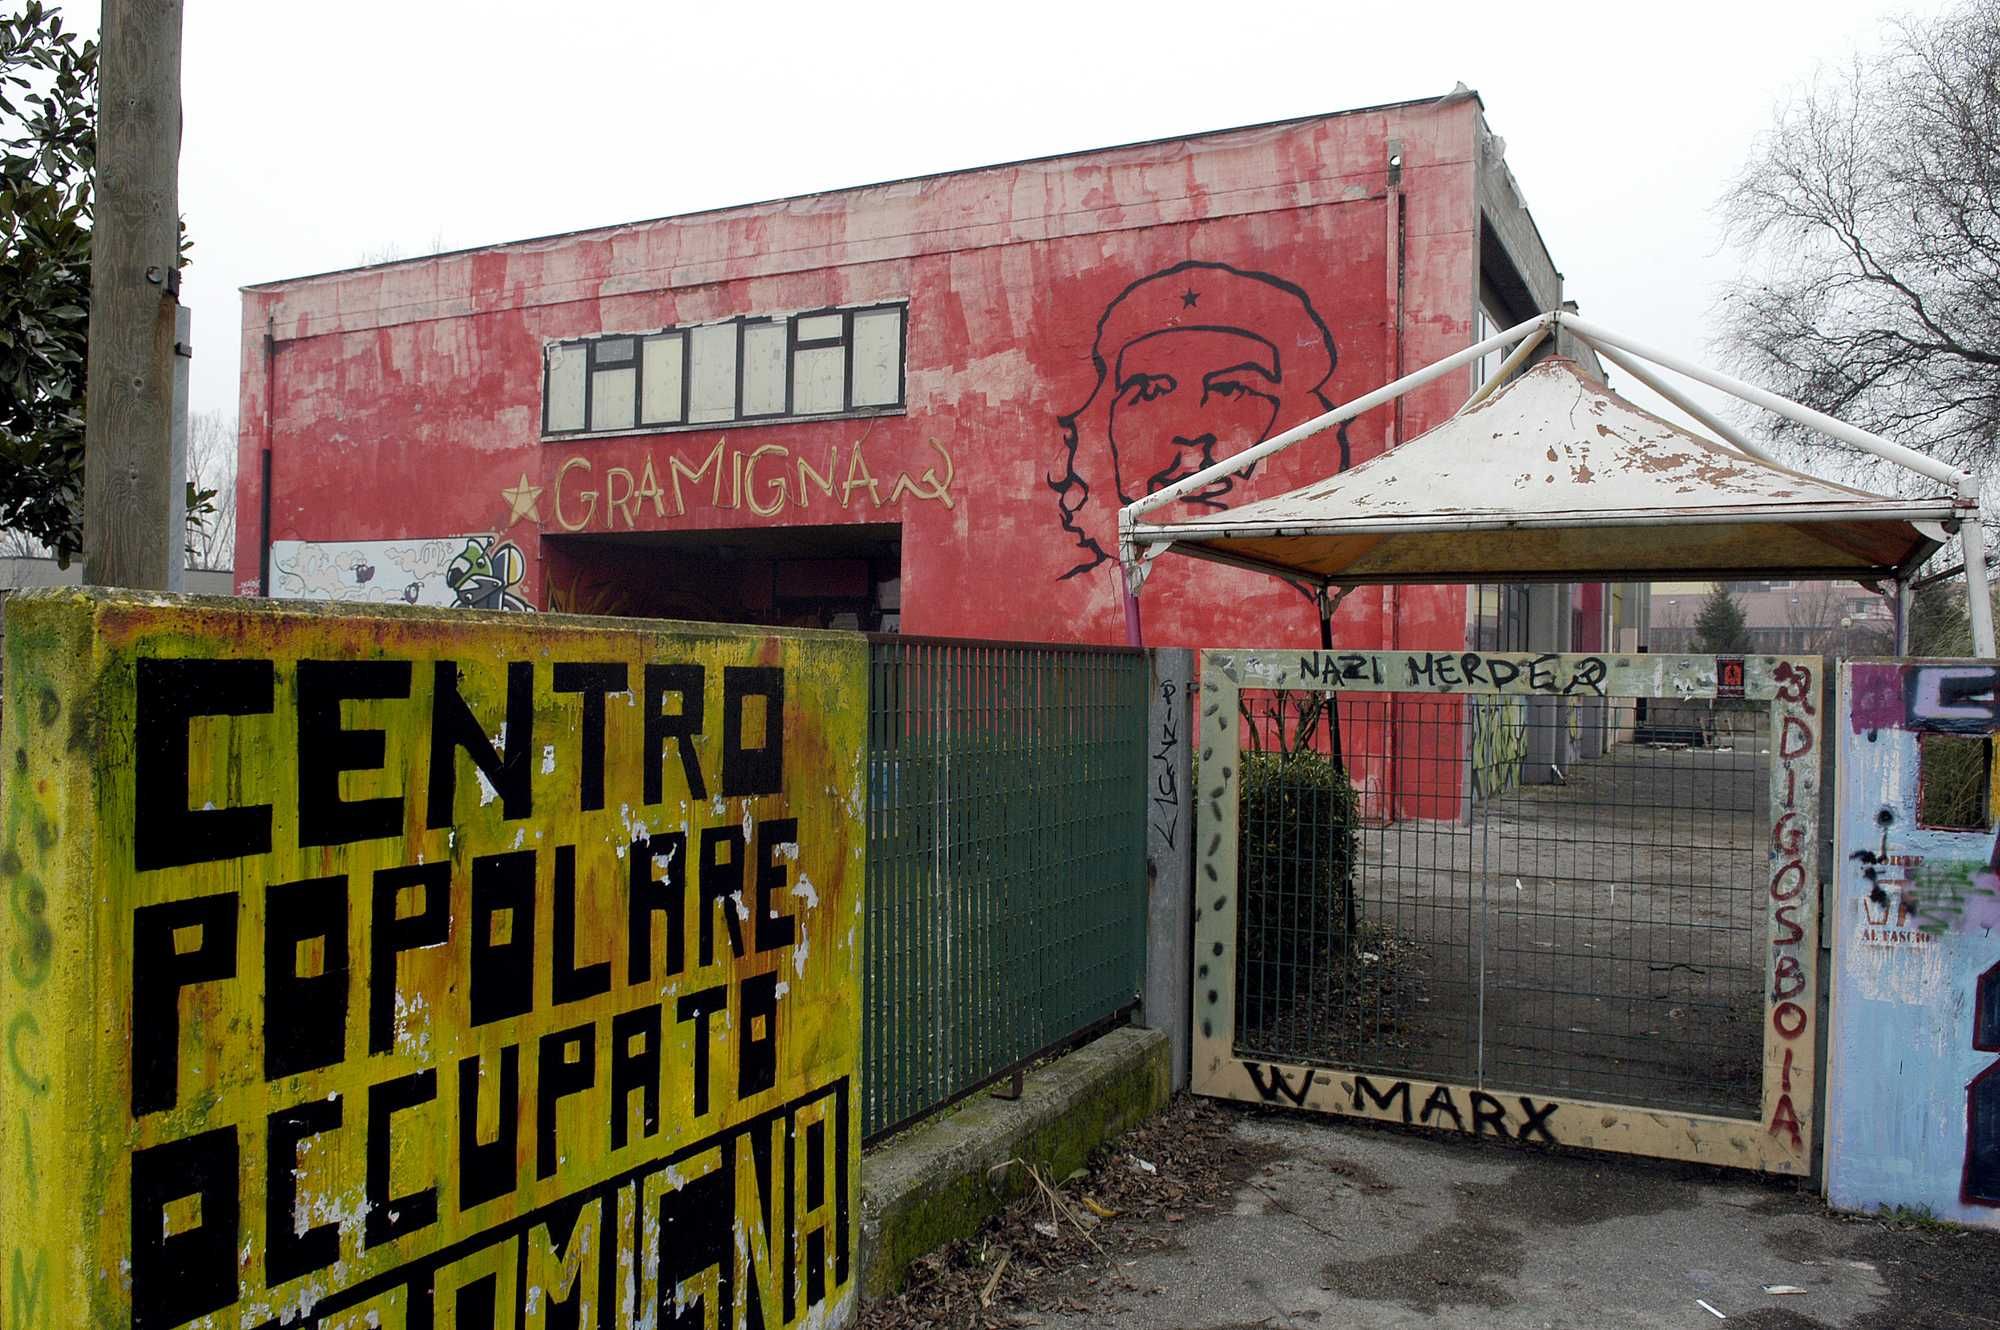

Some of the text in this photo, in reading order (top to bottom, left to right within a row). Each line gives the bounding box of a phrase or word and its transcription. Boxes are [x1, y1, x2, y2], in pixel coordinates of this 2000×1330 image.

[553, 436, 879, 532] GRAMIGNA
[1300, 651, 1562, 691] NAZI MERDE
[135, 657, 785, 871] CENTRO
[131, 817, 799, 1119] POPOLARE
[131, 970, 778, 1329] OCCUPATO
[1243, 1061, 1560, 1145] W MARX
